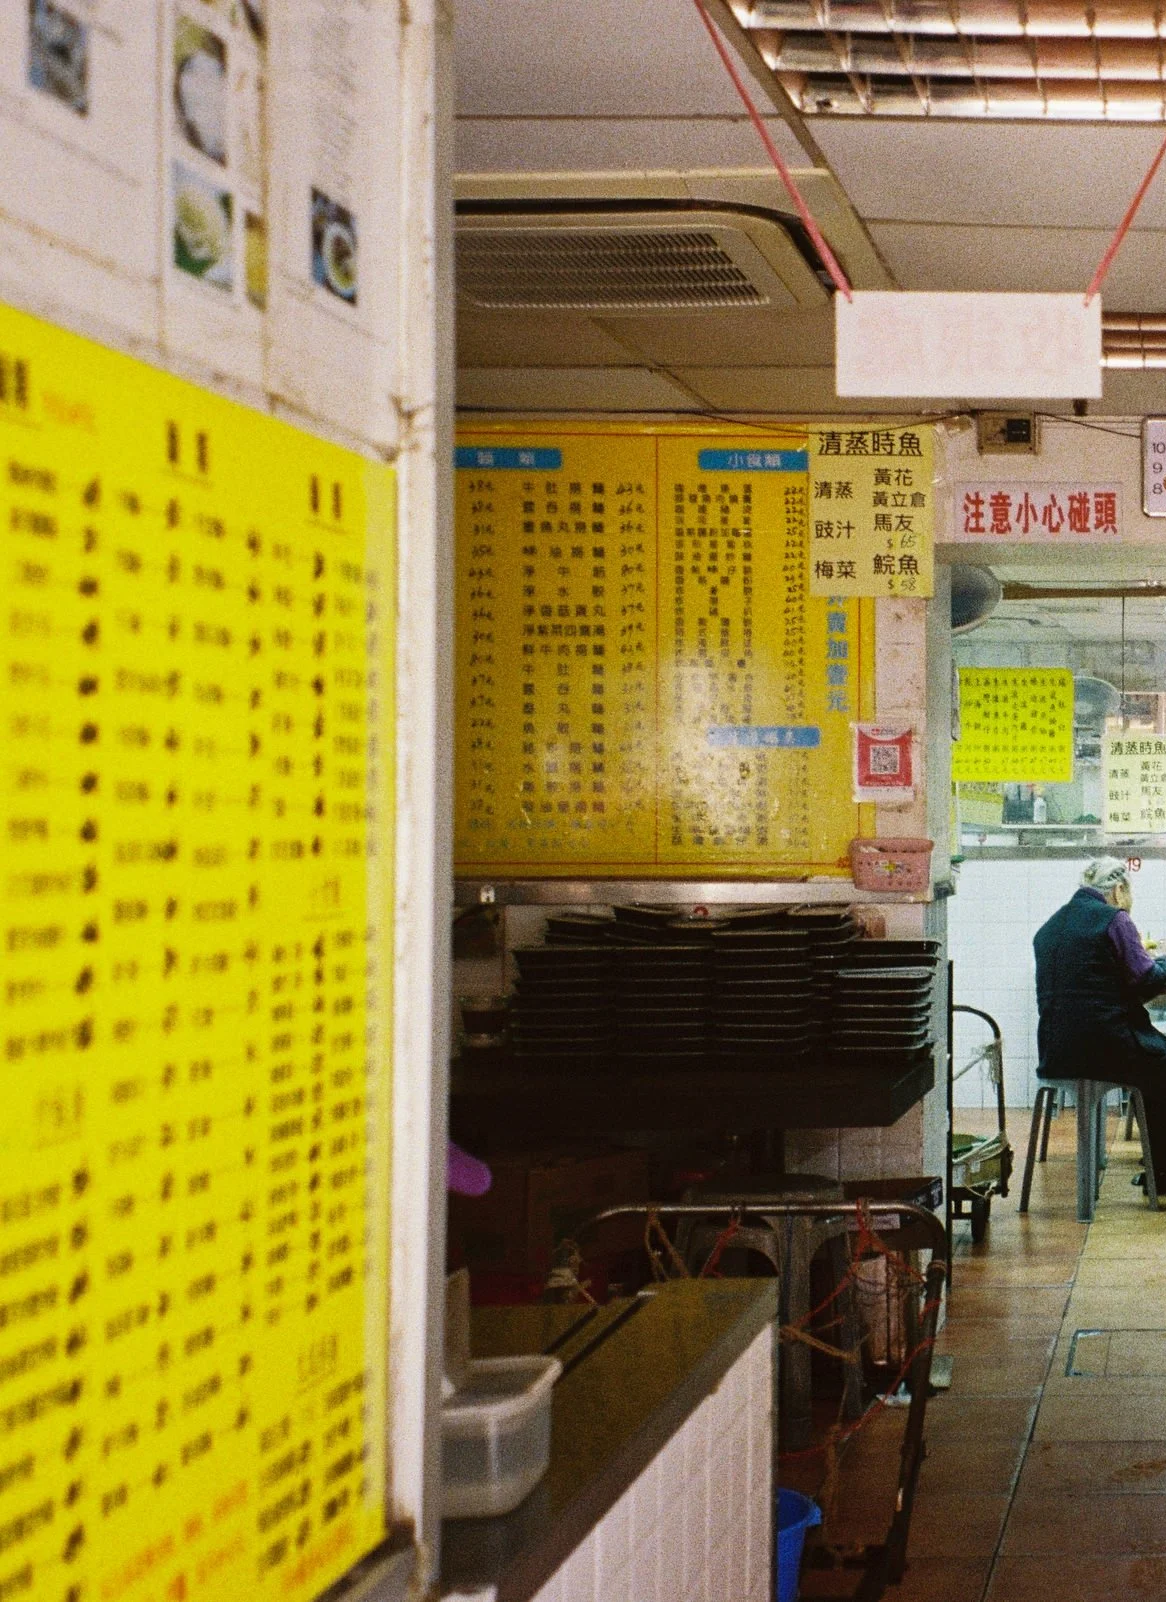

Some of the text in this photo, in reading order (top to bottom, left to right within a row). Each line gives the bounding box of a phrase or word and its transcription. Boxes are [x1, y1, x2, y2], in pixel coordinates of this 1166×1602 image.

[818, 431, 923, 457] 清蒸時魚
[1152, 442, 1166, 454] 10
[874, 468, 913, 486] 黃花
[1152, 462, 1163, 474] 9
[814, 481, 854, 500] 清蒸
[1152, 483, 1163, 495] 8
[872, 491, 926, 508] 黃立倉
[963, 490, 1118, 535] 注意小心碰頭
[814, 520, 856, 539] 豉汁
[874, 514, 914, 532] 馬友
[814, 560, 857, 579] 梅菜
[873, 554, 921, 576] 鯇魚
[1127, 856, 1142, 872] 19
